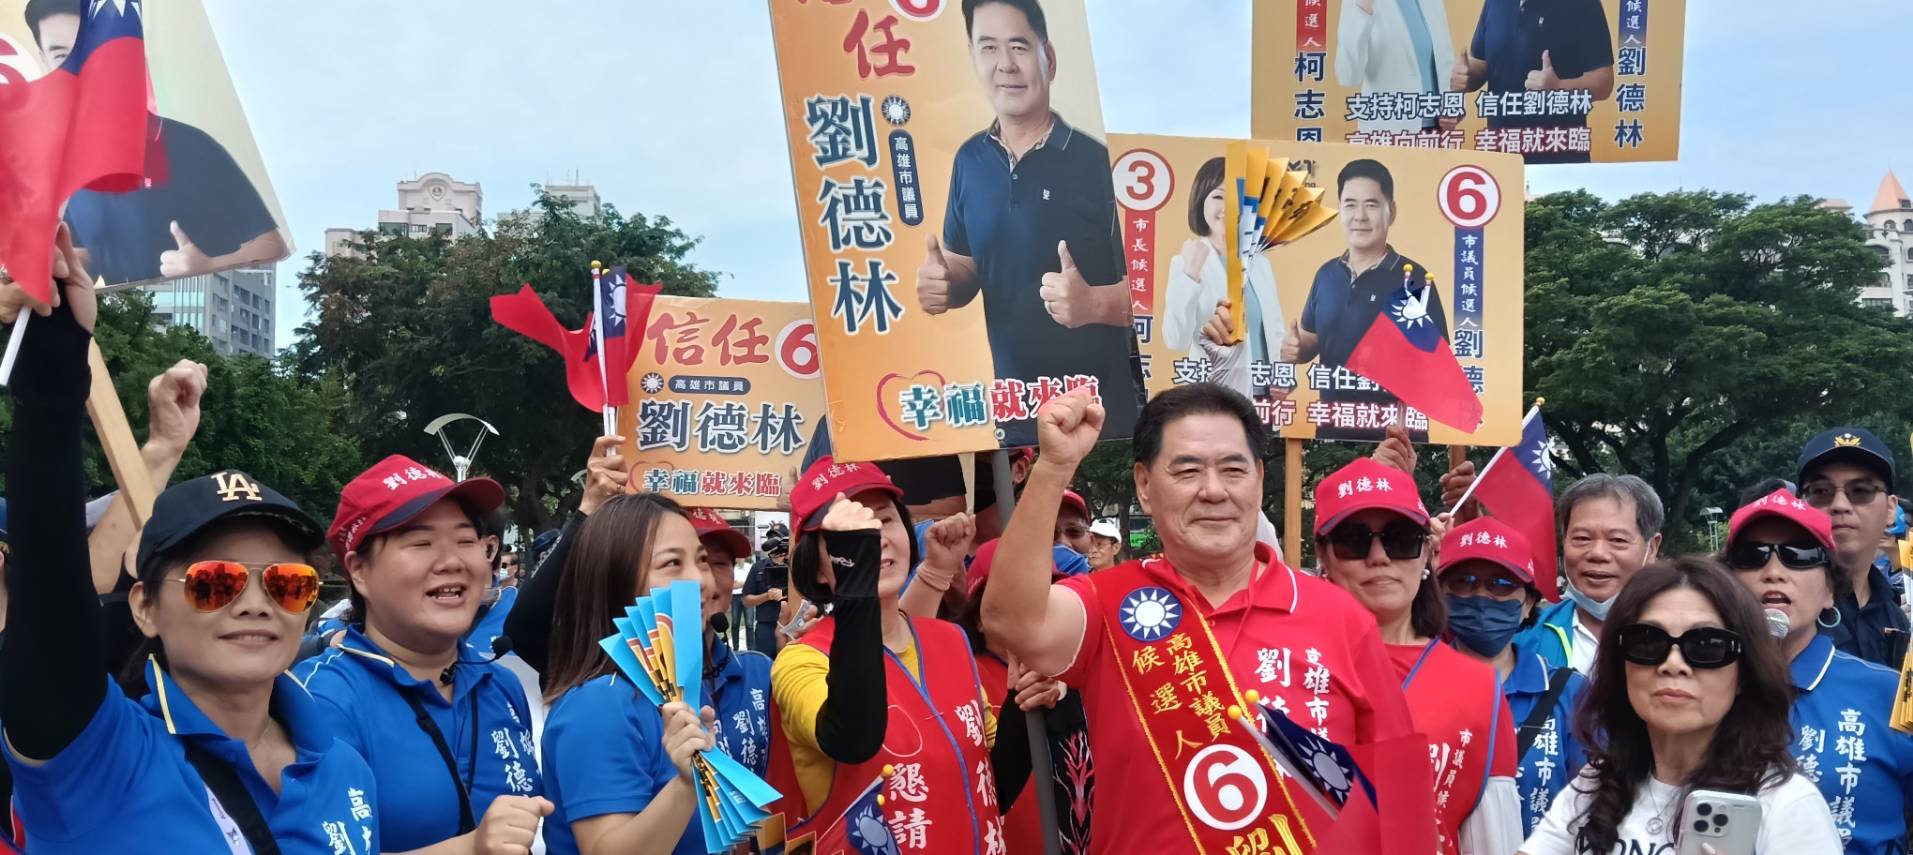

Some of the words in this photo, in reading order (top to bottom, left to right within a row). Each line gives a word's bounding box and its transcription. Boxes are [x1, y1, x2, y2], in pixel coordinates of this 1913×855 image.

[1345, 91, 1465, 121] 支持柯志恩
[1475, 89, 1594, 118] 信任劉德林
[1614, 47, 1647, 148] 劉德林
[1475, 126, 1592, 153] 幸福就來臨
[894, 136, 920, 219] 高雄市議員
[1126, 160, 1156, 200] 3
[1447, 171, 1488, 221] 6
[805, 95, 903, 333] 劉德林
[1130, 218, 1150, 311] 市長候選人
[1459, 234, 1479, 327] 市議員候選人
[647, 312, 770, 366] 信任
[781, 324, 820, 375] 6
[674, 378, 746, 393] 高雄市議員
[638, 400, 805, 452] 劉德林
[211, 471, 263, 502] LA
[642, 468, 782, 496] 幸福就來臨
[811, 463, 862, 491] 劉德林
[1337, 475, 1393, 499] 劉德林
[1459, 530, 1509, 549] 劉德林
[1132, 645, 1204, 760] 候選人
[1165, 632, 1232, 743] 高雄市議員
[491, 727, 534, 798] 劉德
[1193, 750, 1259, 823] 6
[888, 762, 933, 850] 懇請
